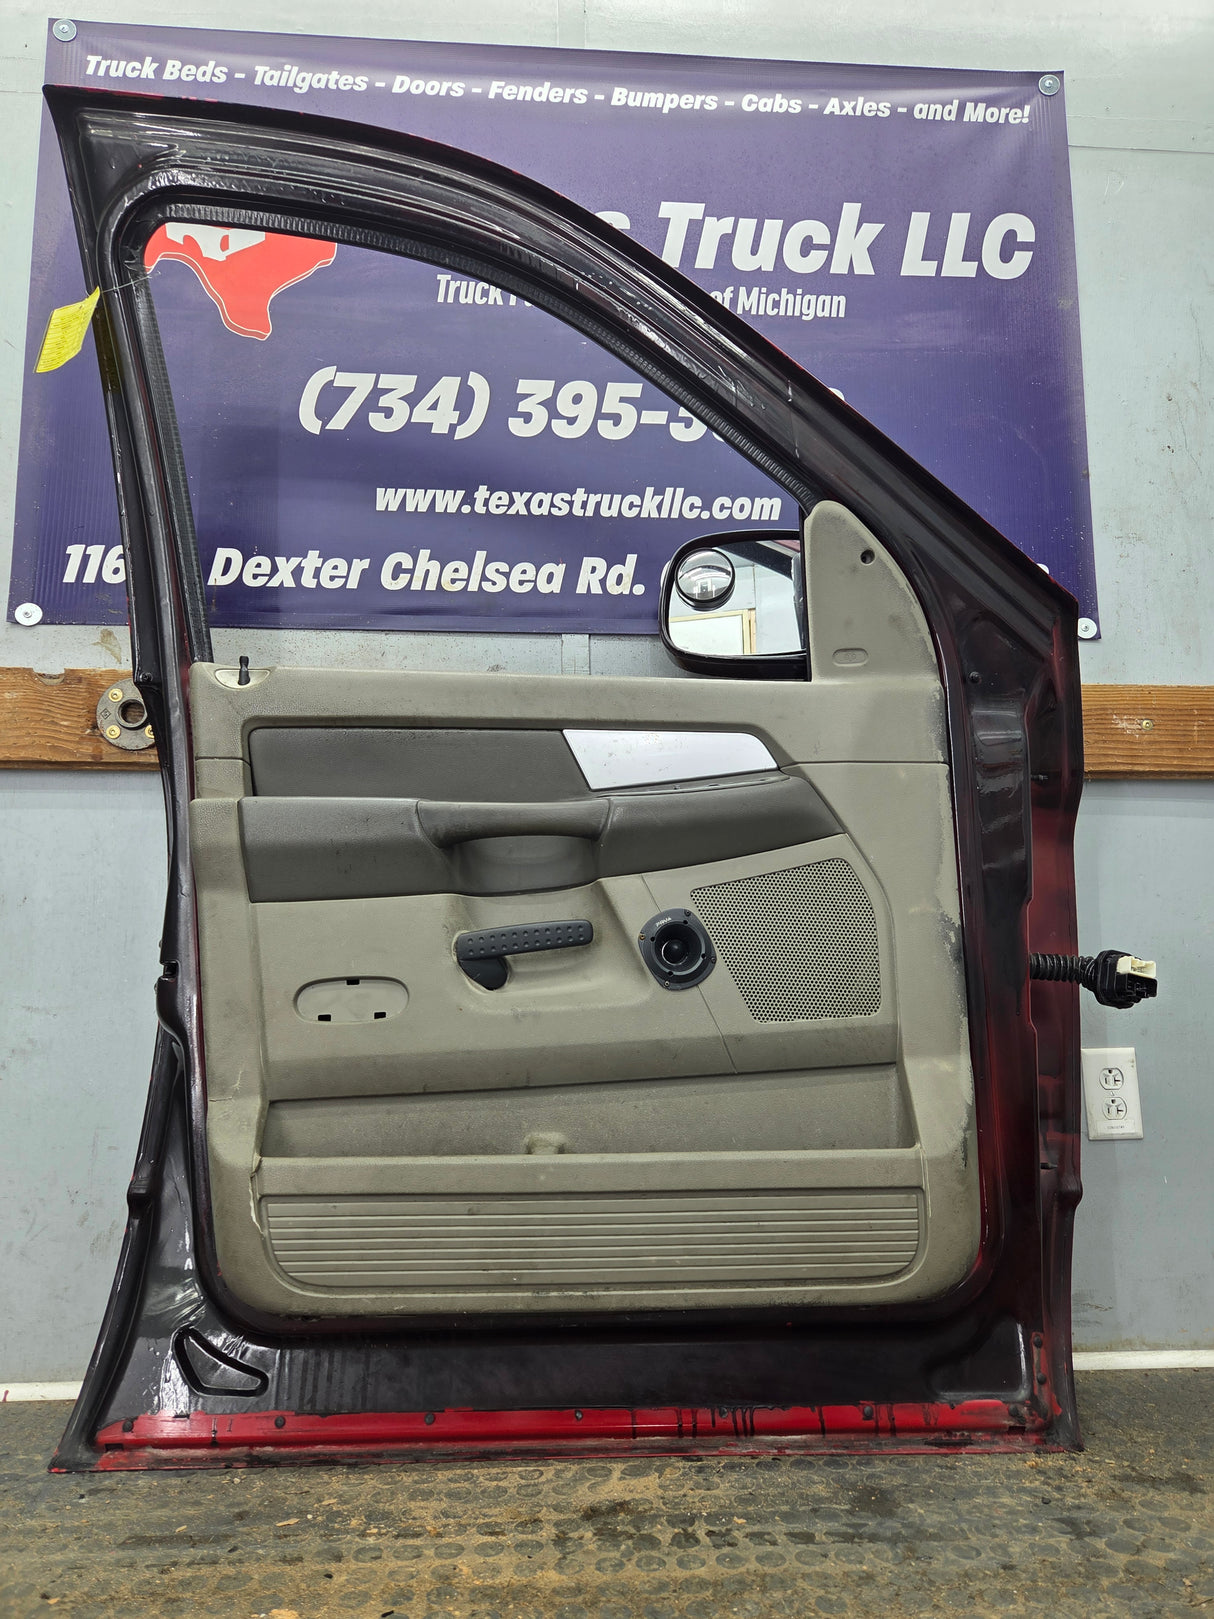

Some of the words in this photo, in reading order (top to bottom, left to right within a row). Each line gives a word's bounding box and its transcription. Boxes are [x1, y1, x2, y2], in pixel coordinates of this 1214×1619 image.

[85, 54, 159, 79] Truck
[162, 59, 228, 83] Beds
[253, 65, 369, 94] Tailgates
[391, 75, 466, 97] Doors
[488, 81, 588, 104] Fenders
[610, 87, 719, 114] Bumpers
[741, 93, 803, 113] Cabs
[823, 97, 892, 118] Axles
[913, 99, 959, 121] and
[963, 101, 1031, 124] More!
[658, 201, 886, 276] Truck
[900, 211, 1036, 280] LLC
[736, 286, 848, 321] Michigan
[298, 365, 491, 441] (734)
[375, 485, 783, 522] www.texastruckllc.com
[62, 544, 129, 585] 116
[207, 547, 371, 591] Dexter
[380, 549, 568, 595] Chelsea
[575, 553, 647, 597] Rd.
